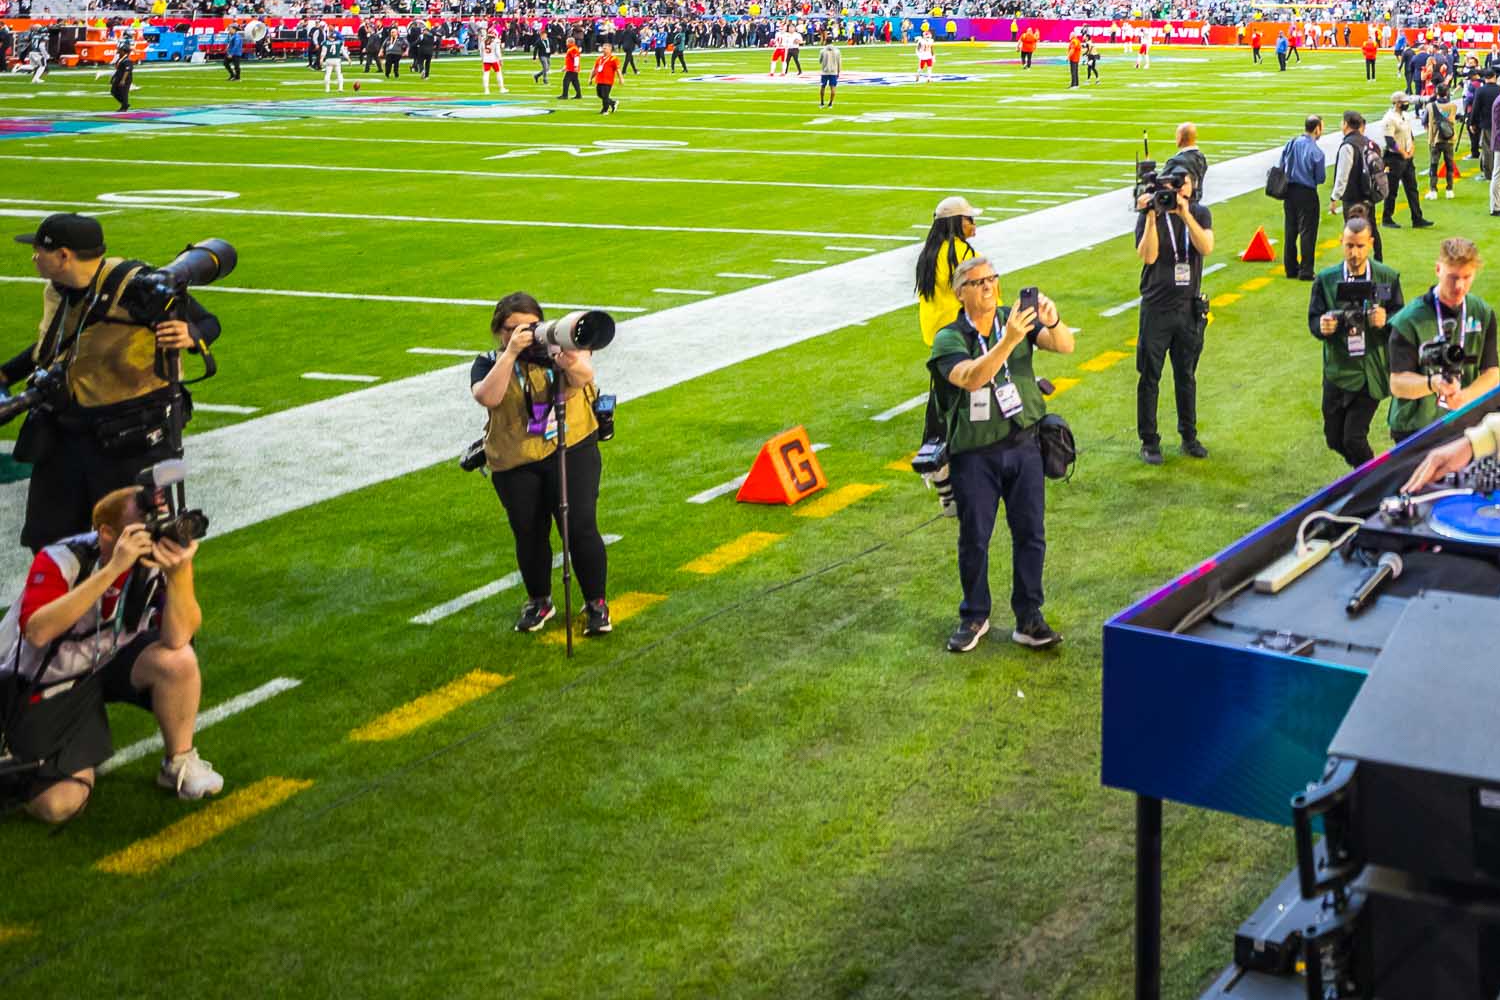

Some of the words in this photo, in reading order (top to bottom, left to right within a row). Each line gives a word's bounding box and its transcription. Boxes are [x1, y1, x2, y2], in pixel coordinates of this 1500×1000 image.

[81, 48, 88, 57] G
[330, 44, 337, 55] 4
[780, 438, 818, 493] G
